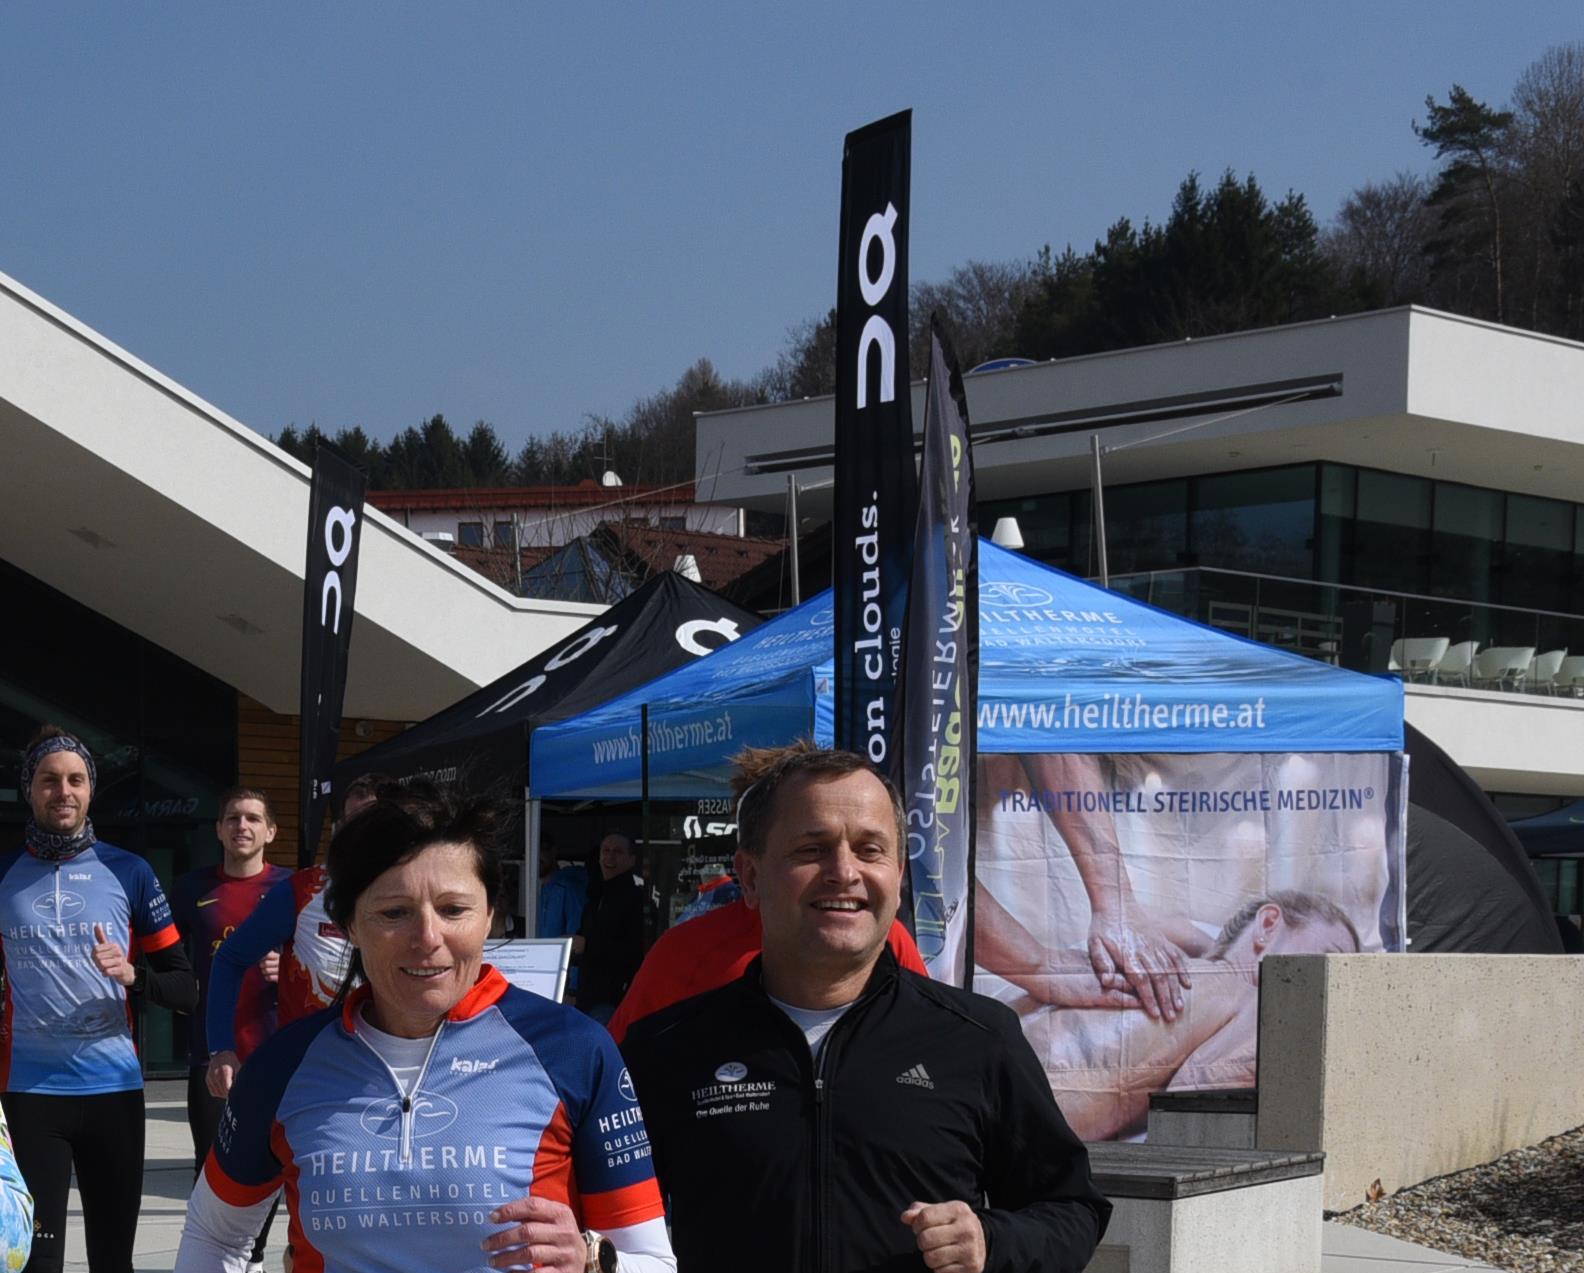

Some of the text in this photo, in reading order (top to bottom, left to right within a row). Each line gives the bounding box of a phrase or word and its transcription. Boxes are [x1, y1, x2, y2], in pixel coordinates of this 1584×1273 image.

[854, 490, 884, 681] clouds.
[977, 692, 1266, 729] www.heiltherme.at
[999, 789, 1148, 814] TRADITIONELL
[1152, 789, 1272, 813] STEIRISCHE
[691, 1081, 777, 1101] HEILTHERME
[896, 1075, 935, 1091] adidas
[734, 1103, 748, 1113] der
[749, 1101, 770, 1111] Ruhe
[311, 1145, 508, 1176] HEILTHERME
[607, 1152, 631, 1168] BAD
[310, 1183, 510, 1205] QUELLENHOTEL
[311, 1210, 489, 1231] BAD WALTERSDO
